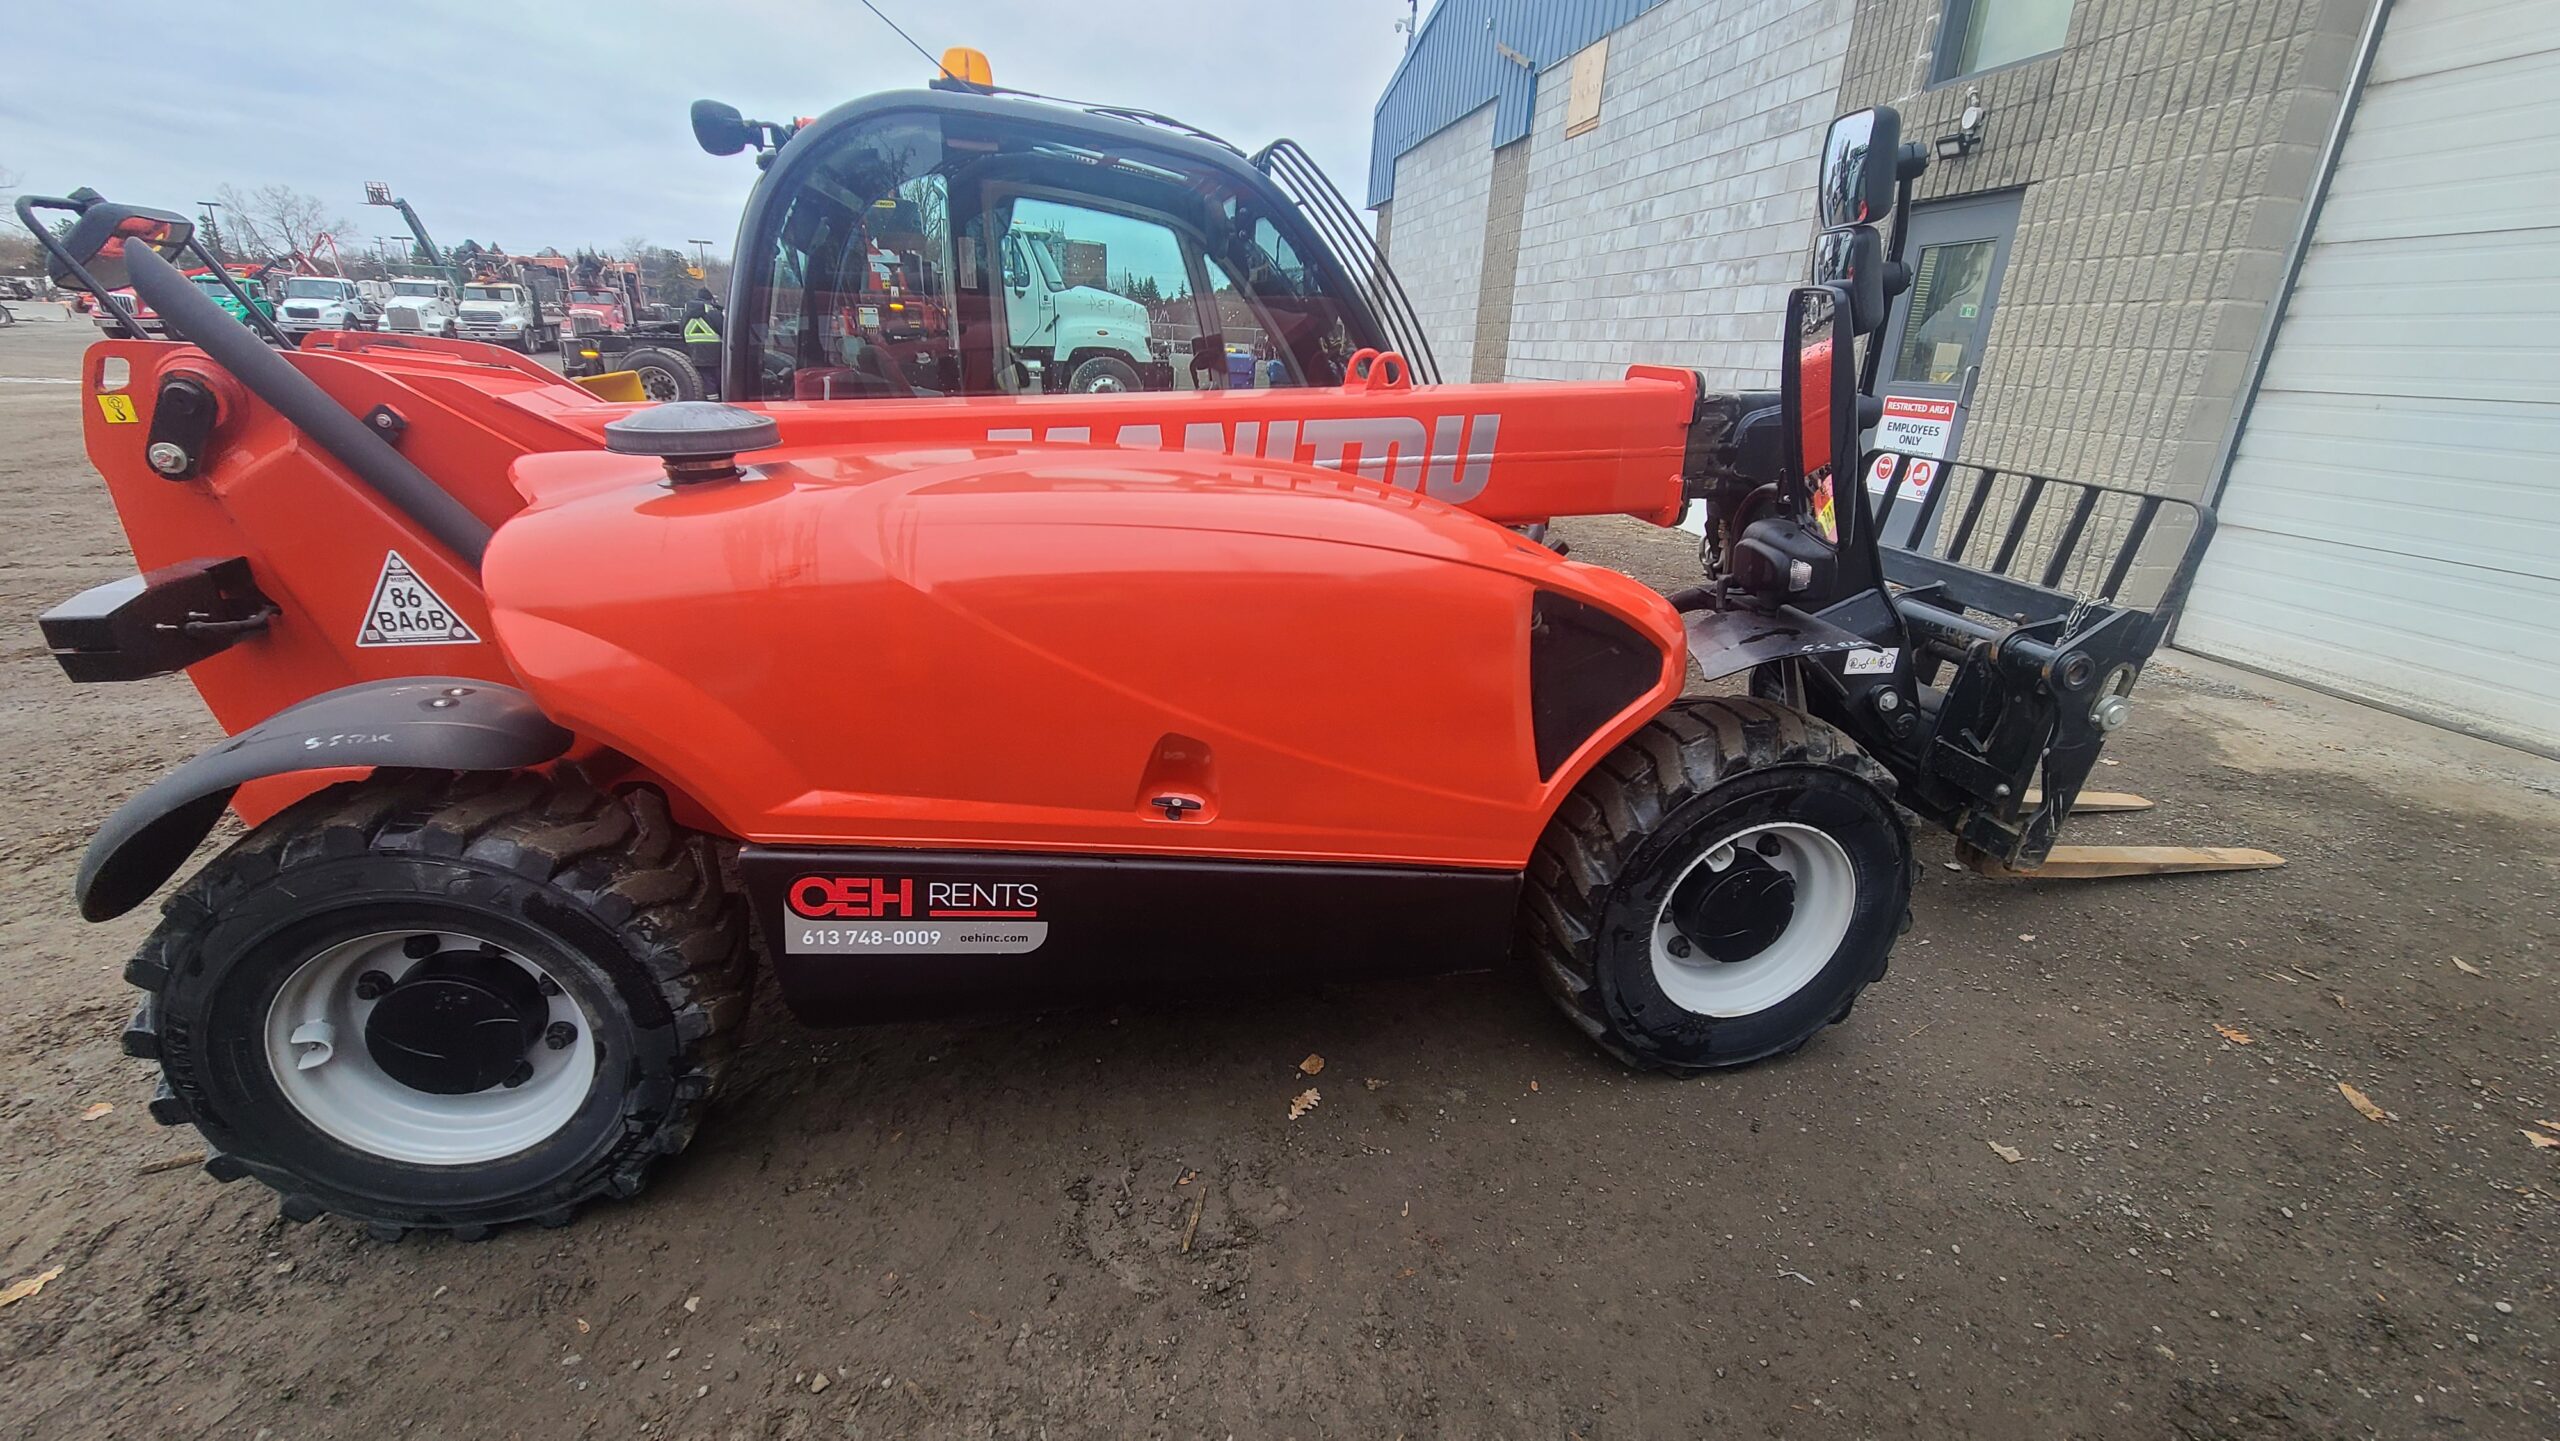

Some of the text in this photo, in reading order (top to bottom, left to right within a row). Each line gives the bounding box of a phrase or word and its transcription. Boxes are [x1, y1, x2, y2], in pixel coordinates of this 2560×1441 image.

[1887, 401, 1950, 415] RESTRICTED AREA
[1887, 421, 1940, 437] EMPLOYEES
[1898, 434, 1922, 446] ONLY
[987, 413, 1501, 505] ITOU
[389, 587, 422, 609] 86
[377, 610, 448, 632] BA6B
[789, 876, 1039, 917] OEH RENTS
[802, 930, 1029, 946] 613 748-0009 oehinc.com
